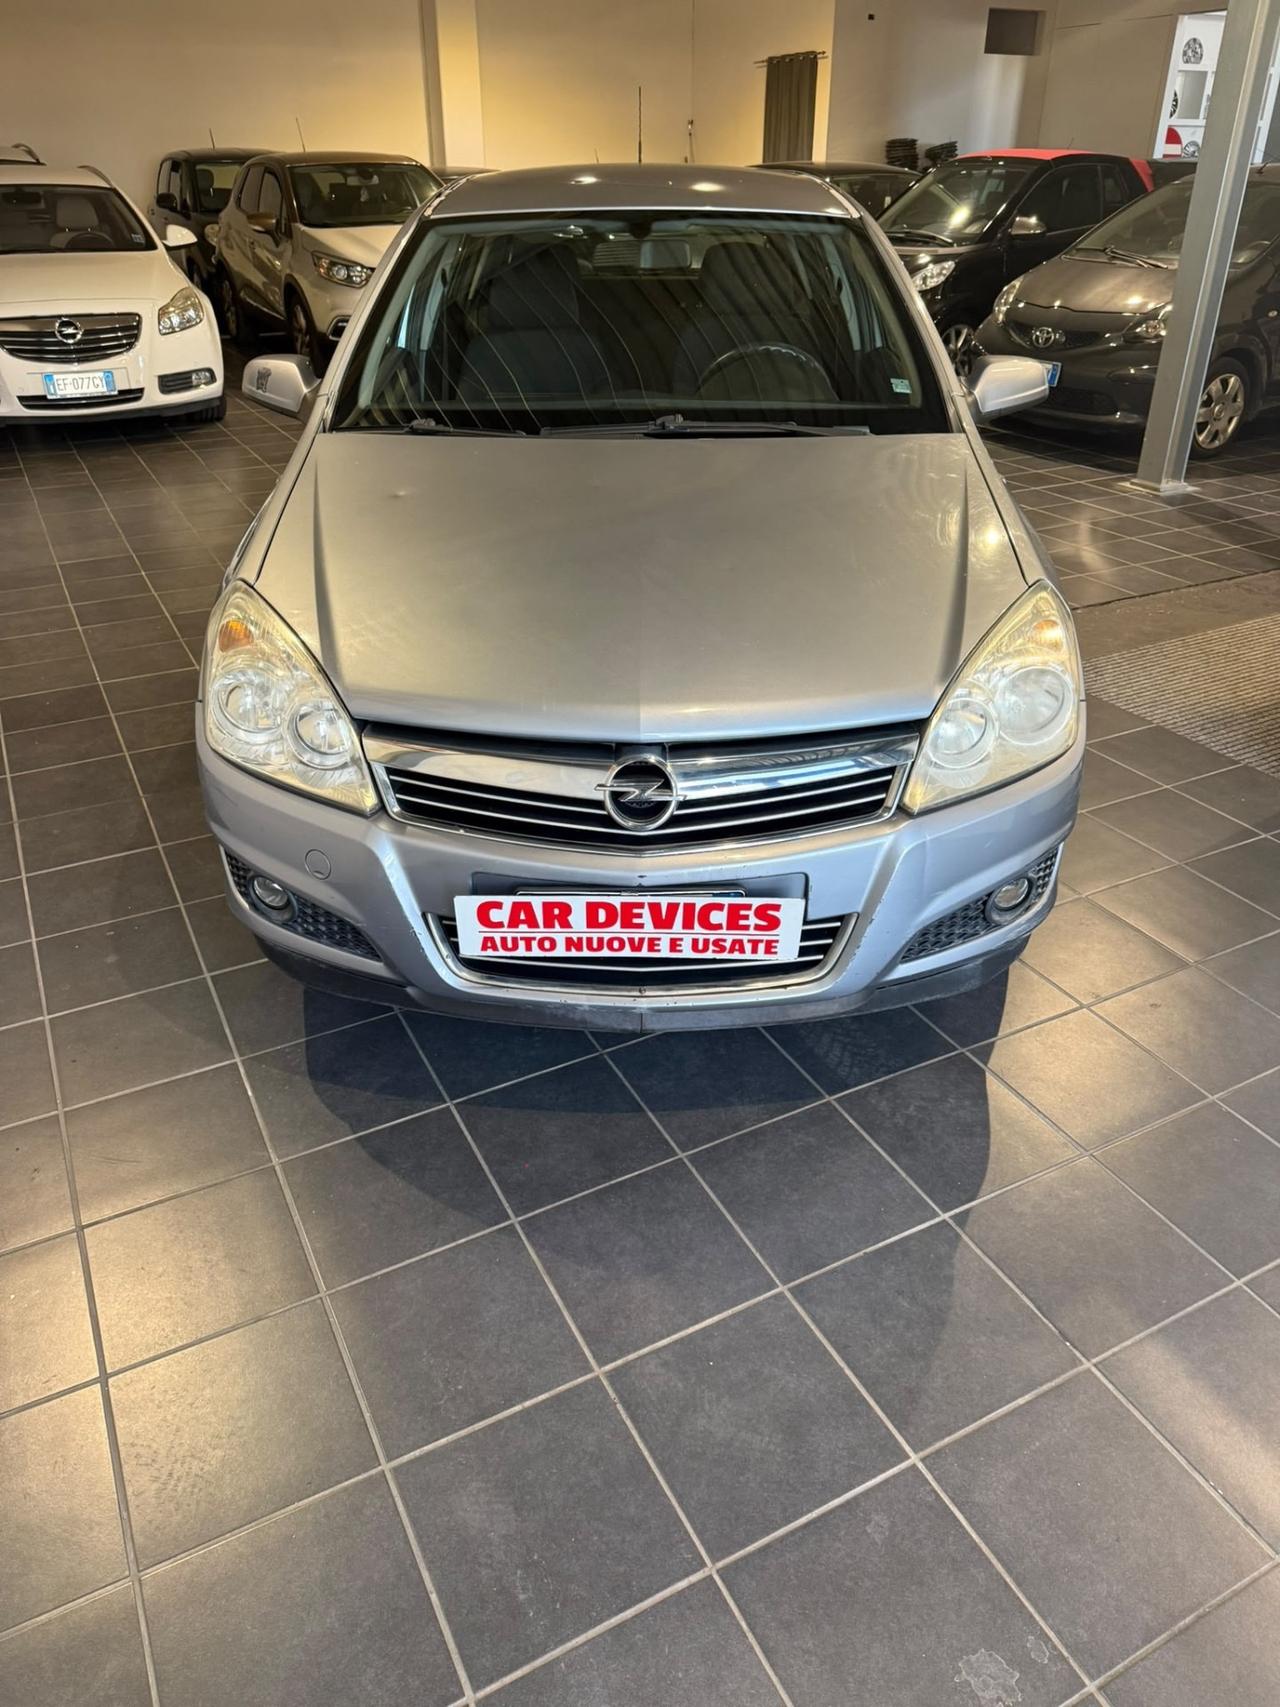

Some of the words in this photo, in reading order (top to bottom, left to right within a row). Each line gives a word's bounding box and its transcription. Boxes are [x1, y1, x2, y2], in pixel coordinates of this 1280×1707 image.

[476, 900, 572, 930] CAR
[585, 901, 781, 933] DEVICES
[480, 936, 557, 953] AUTO
[564, 936, 660, 953] NUOVE
[668, 937, 682, 954] E
[691, 937, 778, 956] USATE
